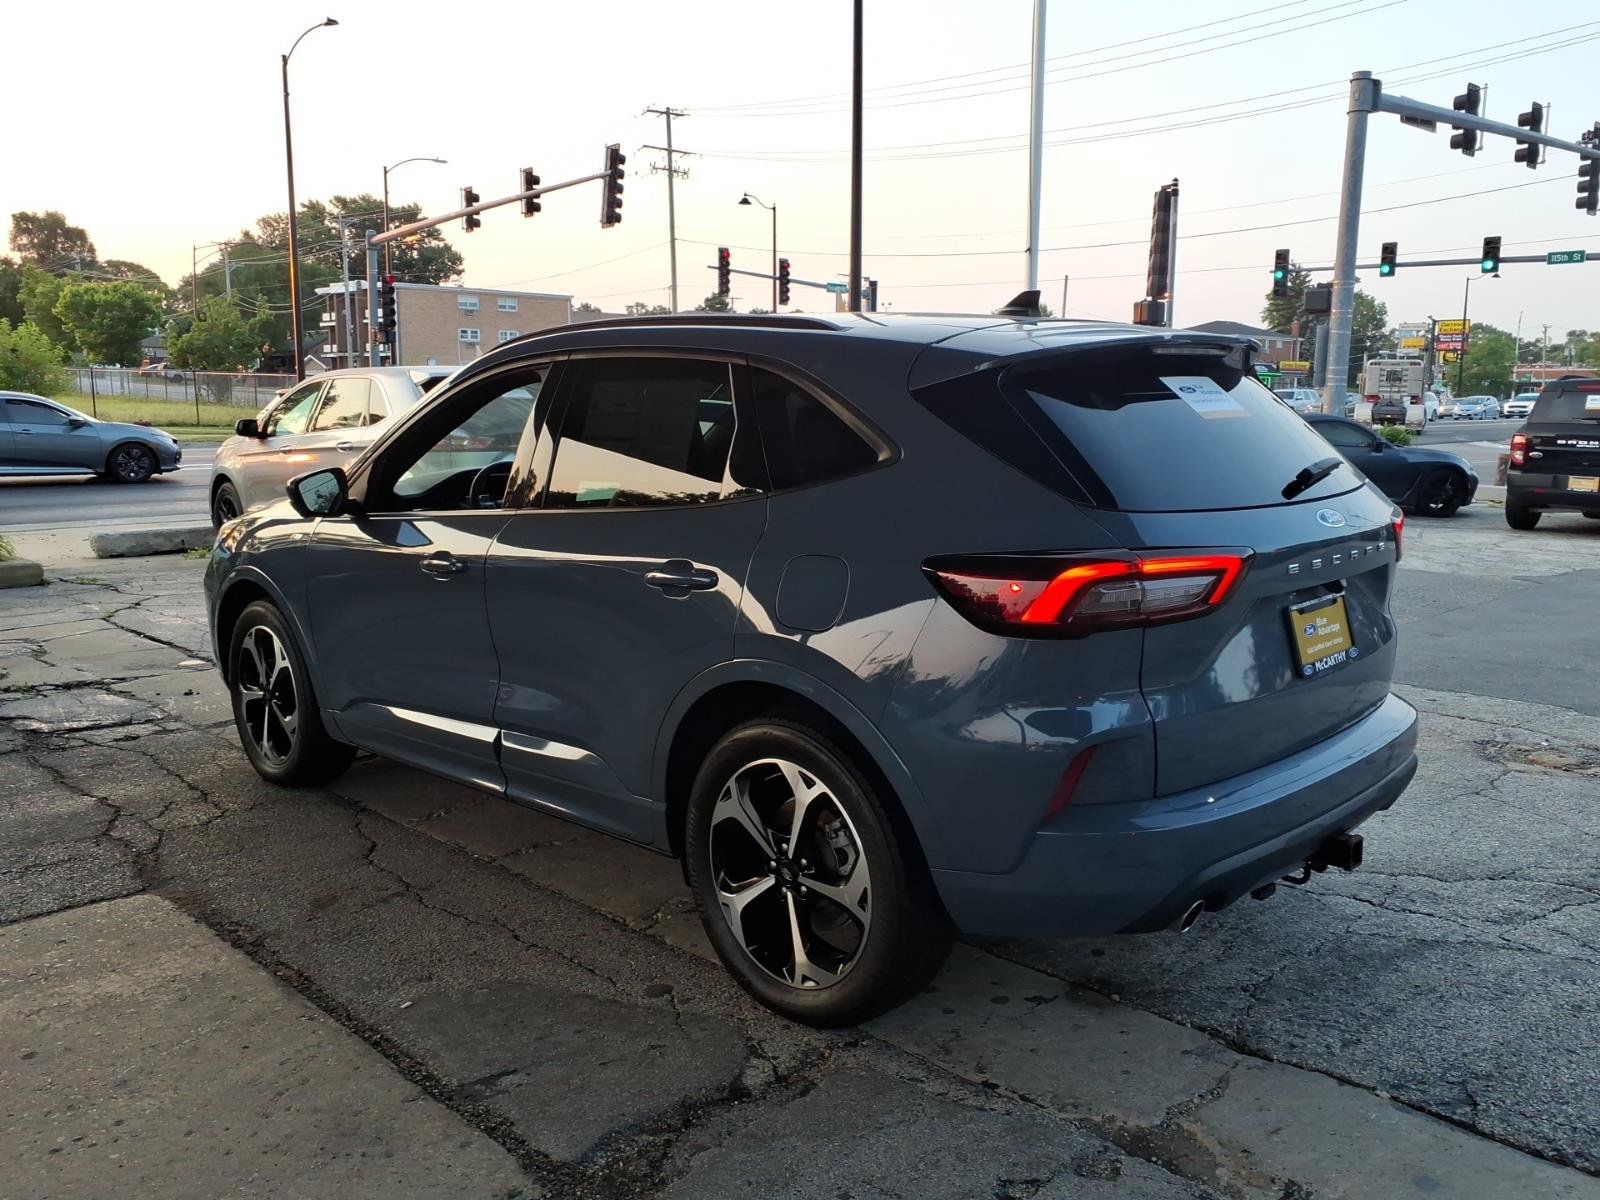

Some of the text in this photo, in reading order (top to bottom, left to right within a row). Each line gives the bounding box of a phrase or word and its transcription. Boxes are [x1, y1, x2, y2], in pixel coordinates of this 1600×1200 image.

[1551, 252, 1581, 262] 115th St
[1288, 542, 1385, 574] ESCAPE
[1314, 651, 1347, 672] McCARTHY
